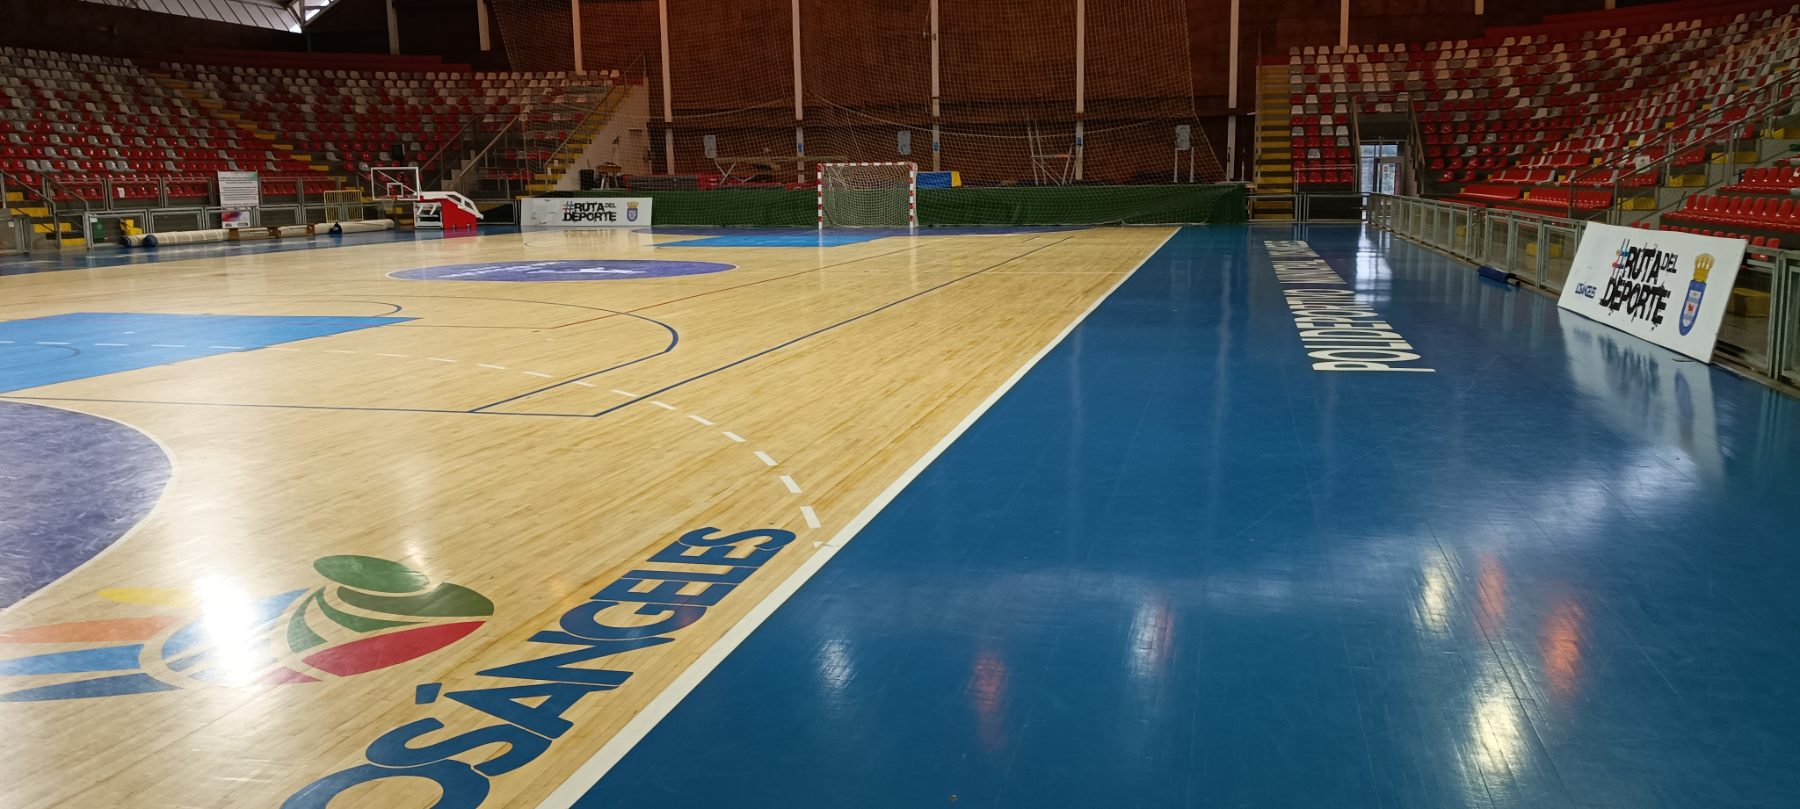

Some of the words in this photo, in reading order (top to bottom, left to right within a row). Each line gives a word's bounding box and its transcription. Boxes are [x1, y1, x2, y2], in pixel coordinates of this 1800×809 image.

[562, 201, 605, 213] #RUTA
[562, 211, 617, 222] DEPORTE
[1611, 238, 1663, 285] #RUTA
[1660, 252, 1679, 274] DEL
[1599, 277, 1671, 325] DEPORTE
[1283, 288, 1436, 372] POLIDEPORTIVO
